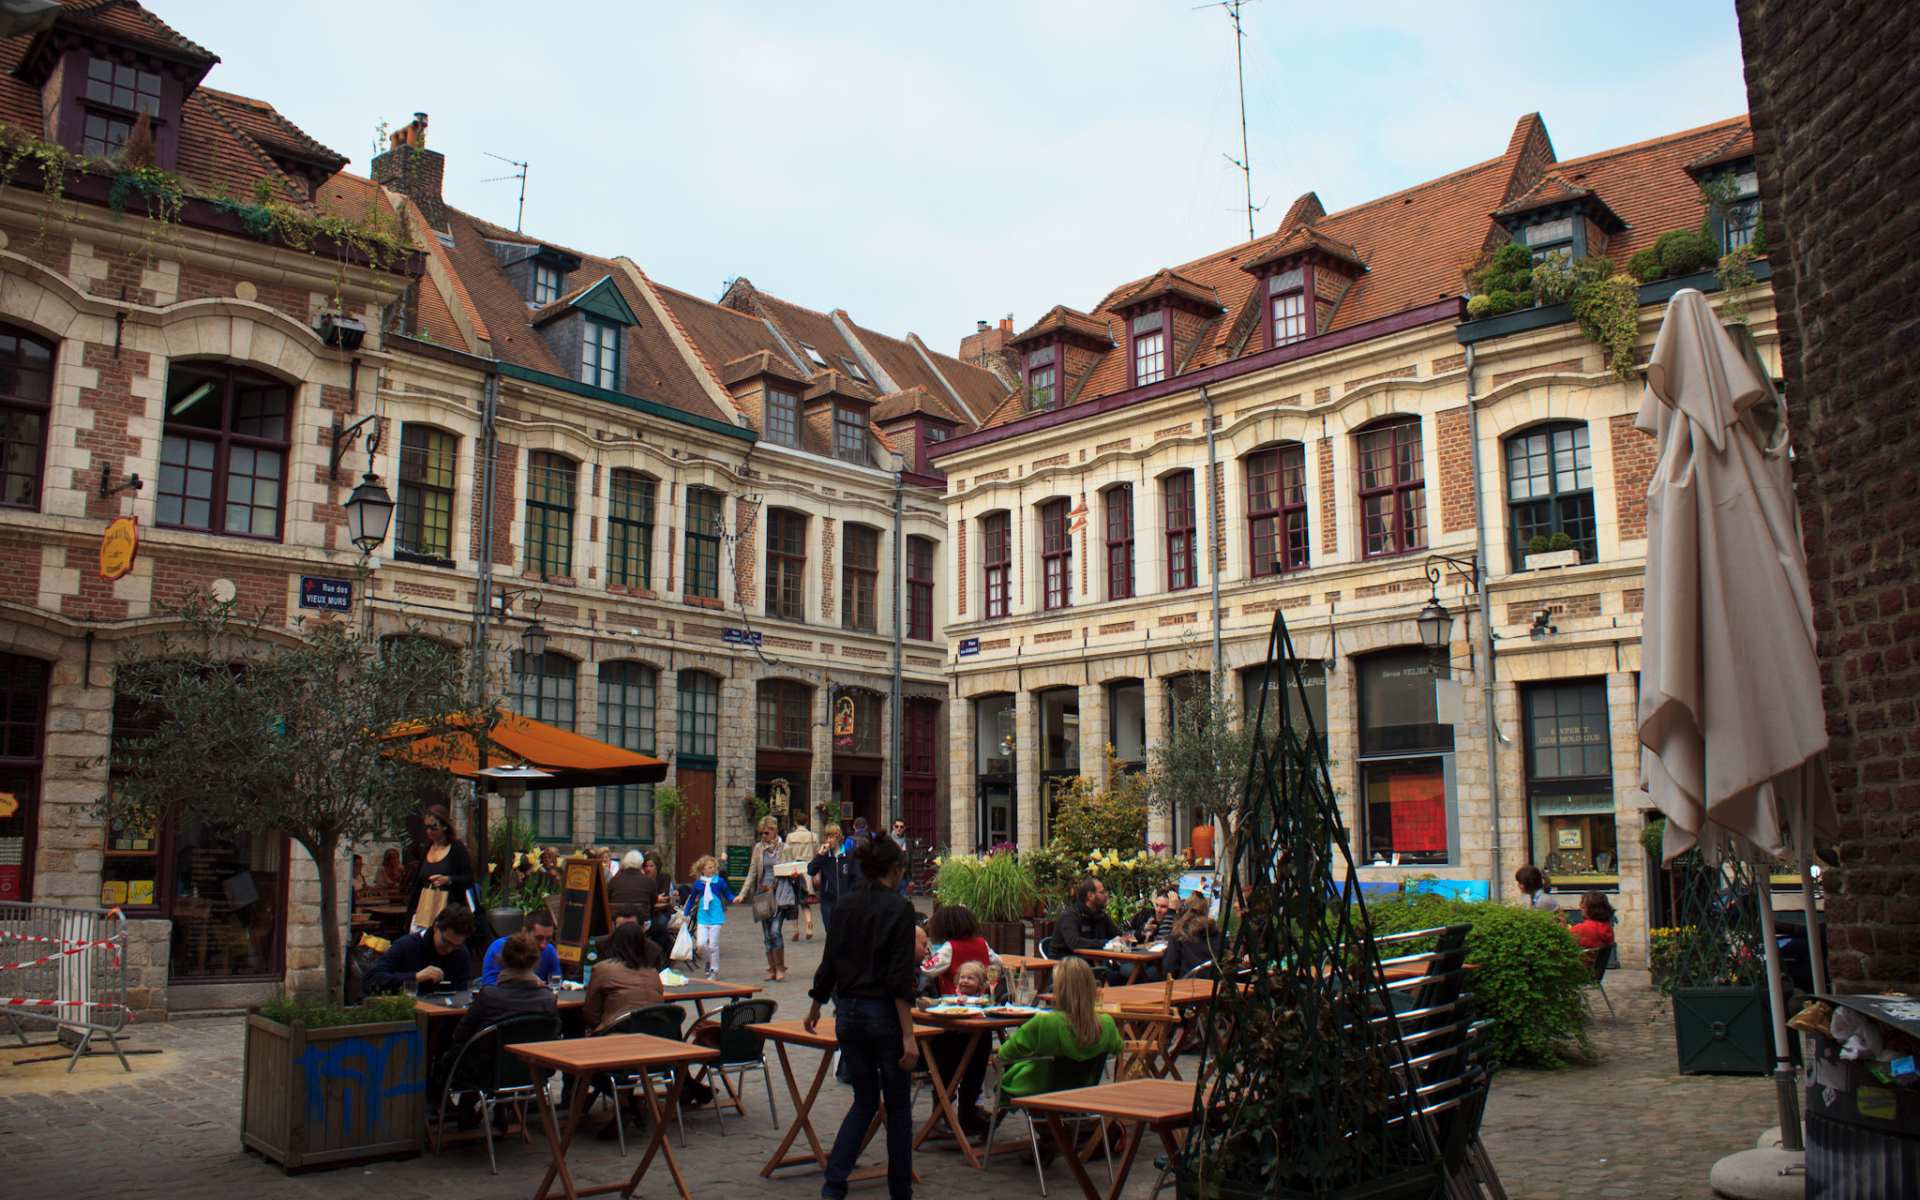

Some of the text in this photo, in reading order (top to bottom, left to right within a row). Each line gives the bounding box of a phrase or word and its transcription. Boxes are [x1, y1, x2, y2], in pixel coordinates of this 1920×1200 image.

[322, 583, 348, 594] Rue des
[306, 594, 347, 606] VIEUX MURS
[1403, 666, 1440, 676] VELJKOIC
[1551, 727, 1589, 735] EXPERT
[1539, 734, 1601, 743] GEMMOLOGUE
